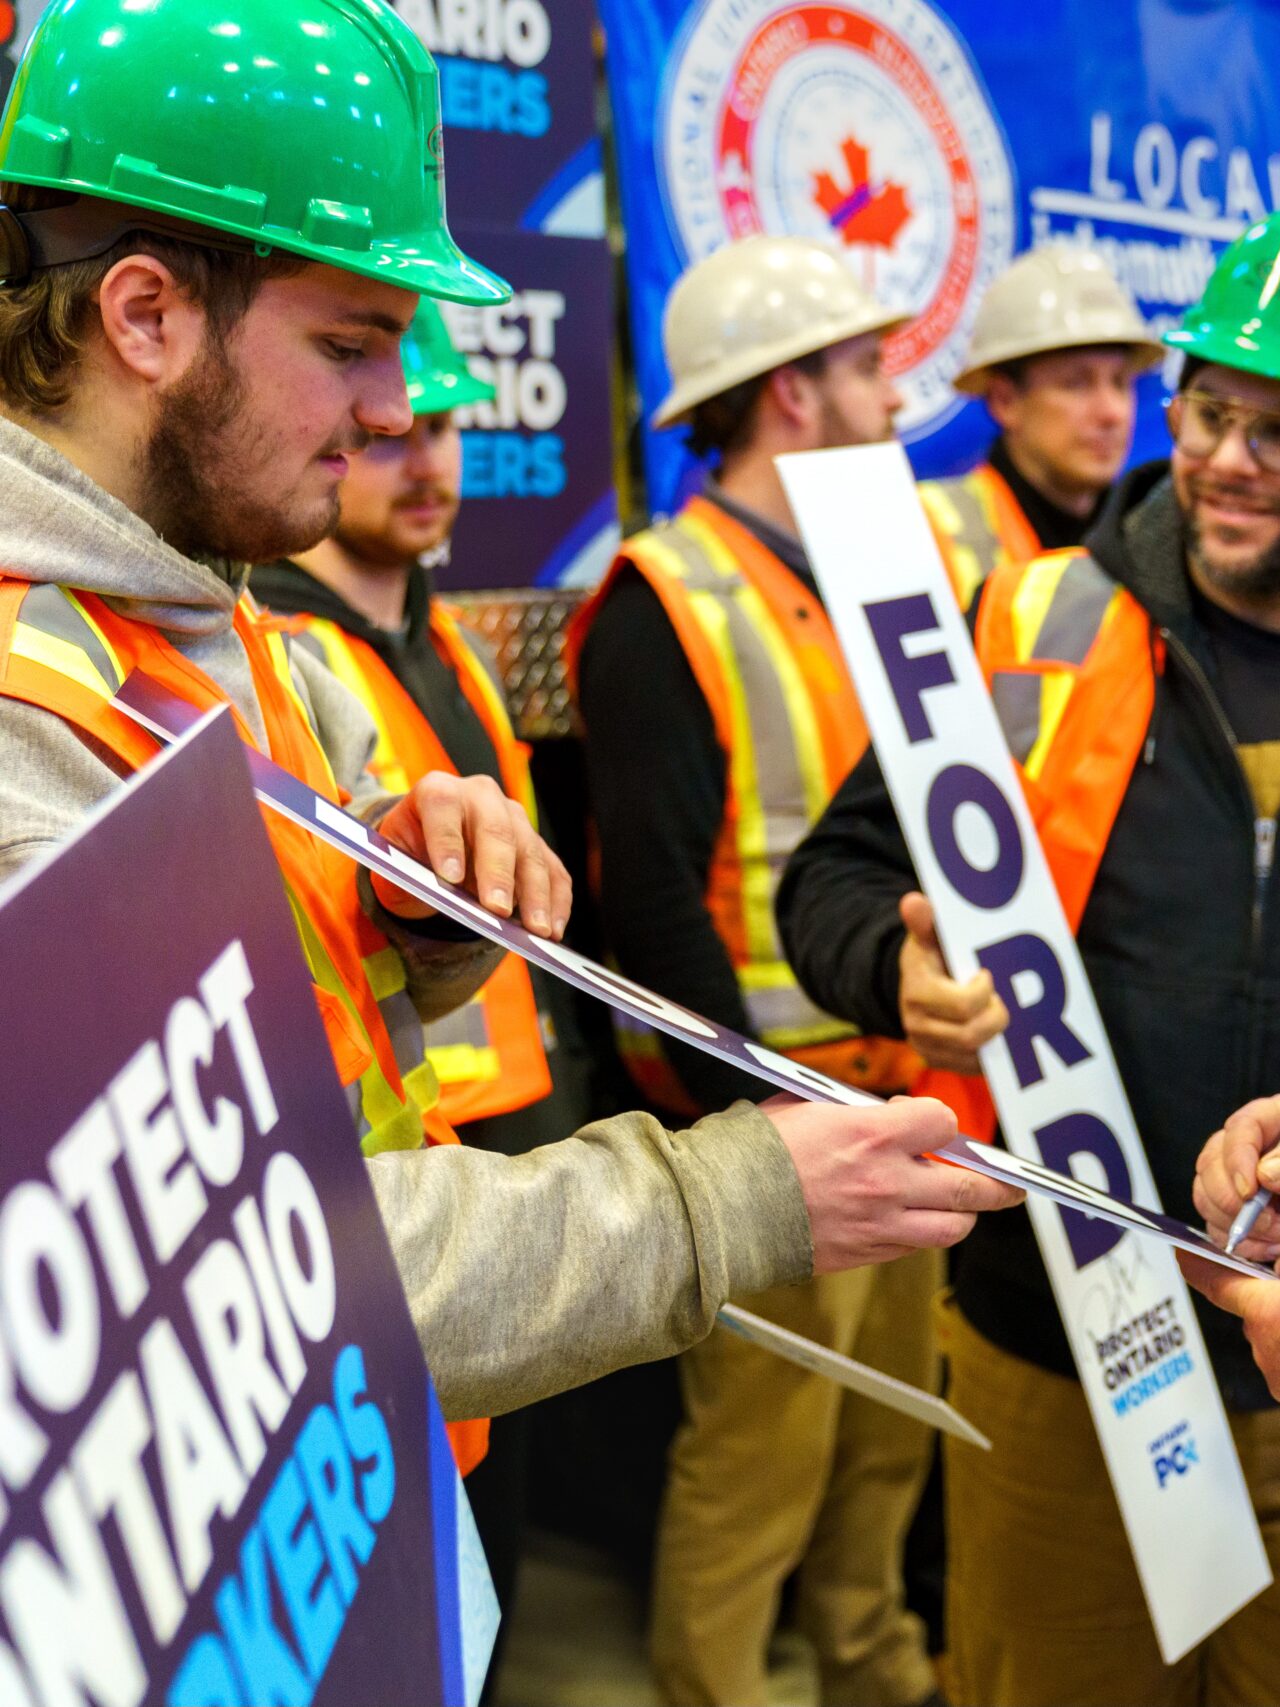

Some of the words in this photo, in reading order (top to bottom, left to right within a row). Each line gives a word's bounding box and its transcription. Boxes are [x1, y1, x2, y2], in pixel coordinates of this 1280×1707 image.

[863, 593, 1132, 1271] FORD
[0, 1151, 336, 1707] NTARIO
[1095, 1297, 1177, 1361] PROTECT
[1103, 1325, 1186, 1390] ONTARIO
